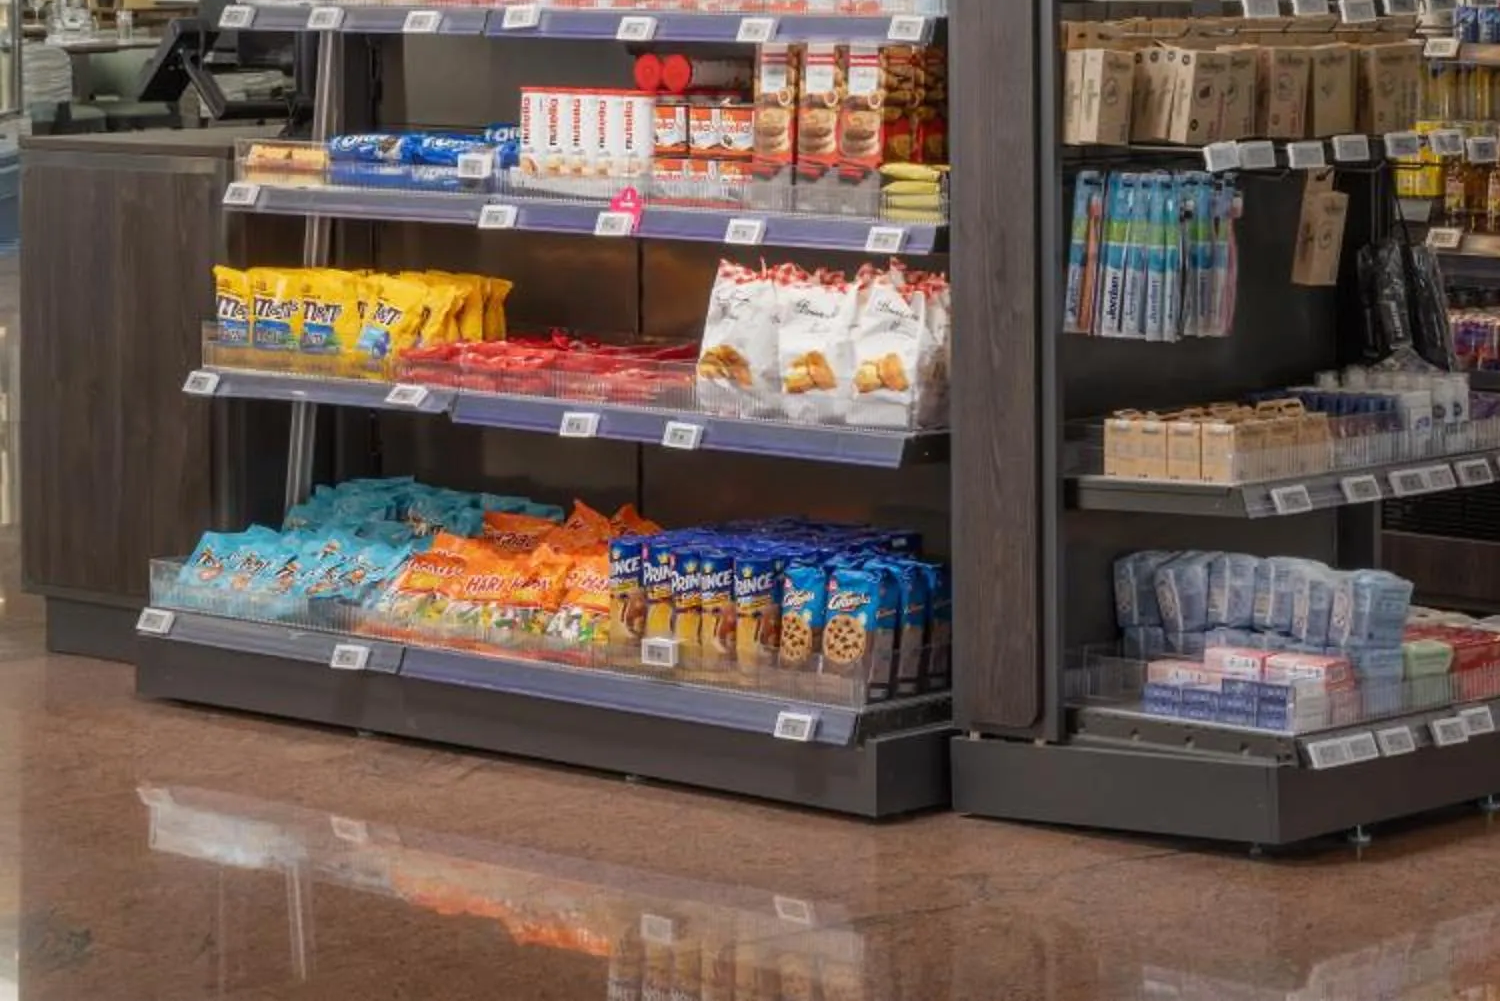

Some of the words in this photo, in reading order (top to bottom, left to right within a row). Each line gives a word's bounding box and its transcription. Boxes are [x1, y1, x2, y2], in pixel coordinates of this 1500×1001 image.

[548, 98, 559, 147] nutella
[644, 561, 672, 586] PRIN
[671, 570, 701, 592] PRIN
